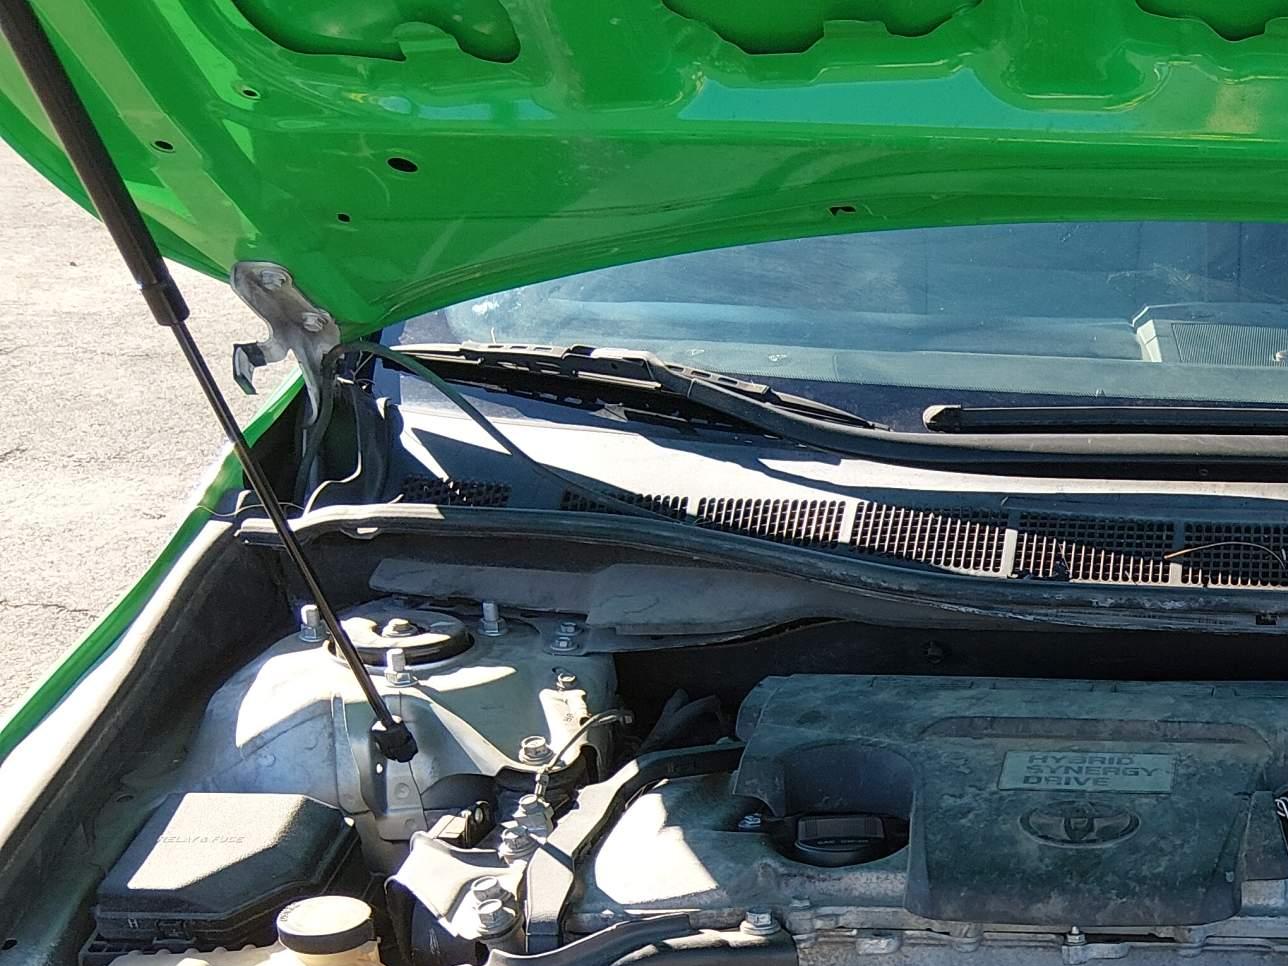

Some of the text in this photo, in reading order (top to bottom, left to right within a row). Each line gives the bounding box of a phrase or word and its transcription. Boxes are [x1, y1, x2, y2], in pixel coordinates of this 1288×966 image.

[1028, 754, 1135, 766] HYBRID
[1025, 764, 1159, 777] SYNERGY
[1022, 775, 1111, 787] DRIVE
